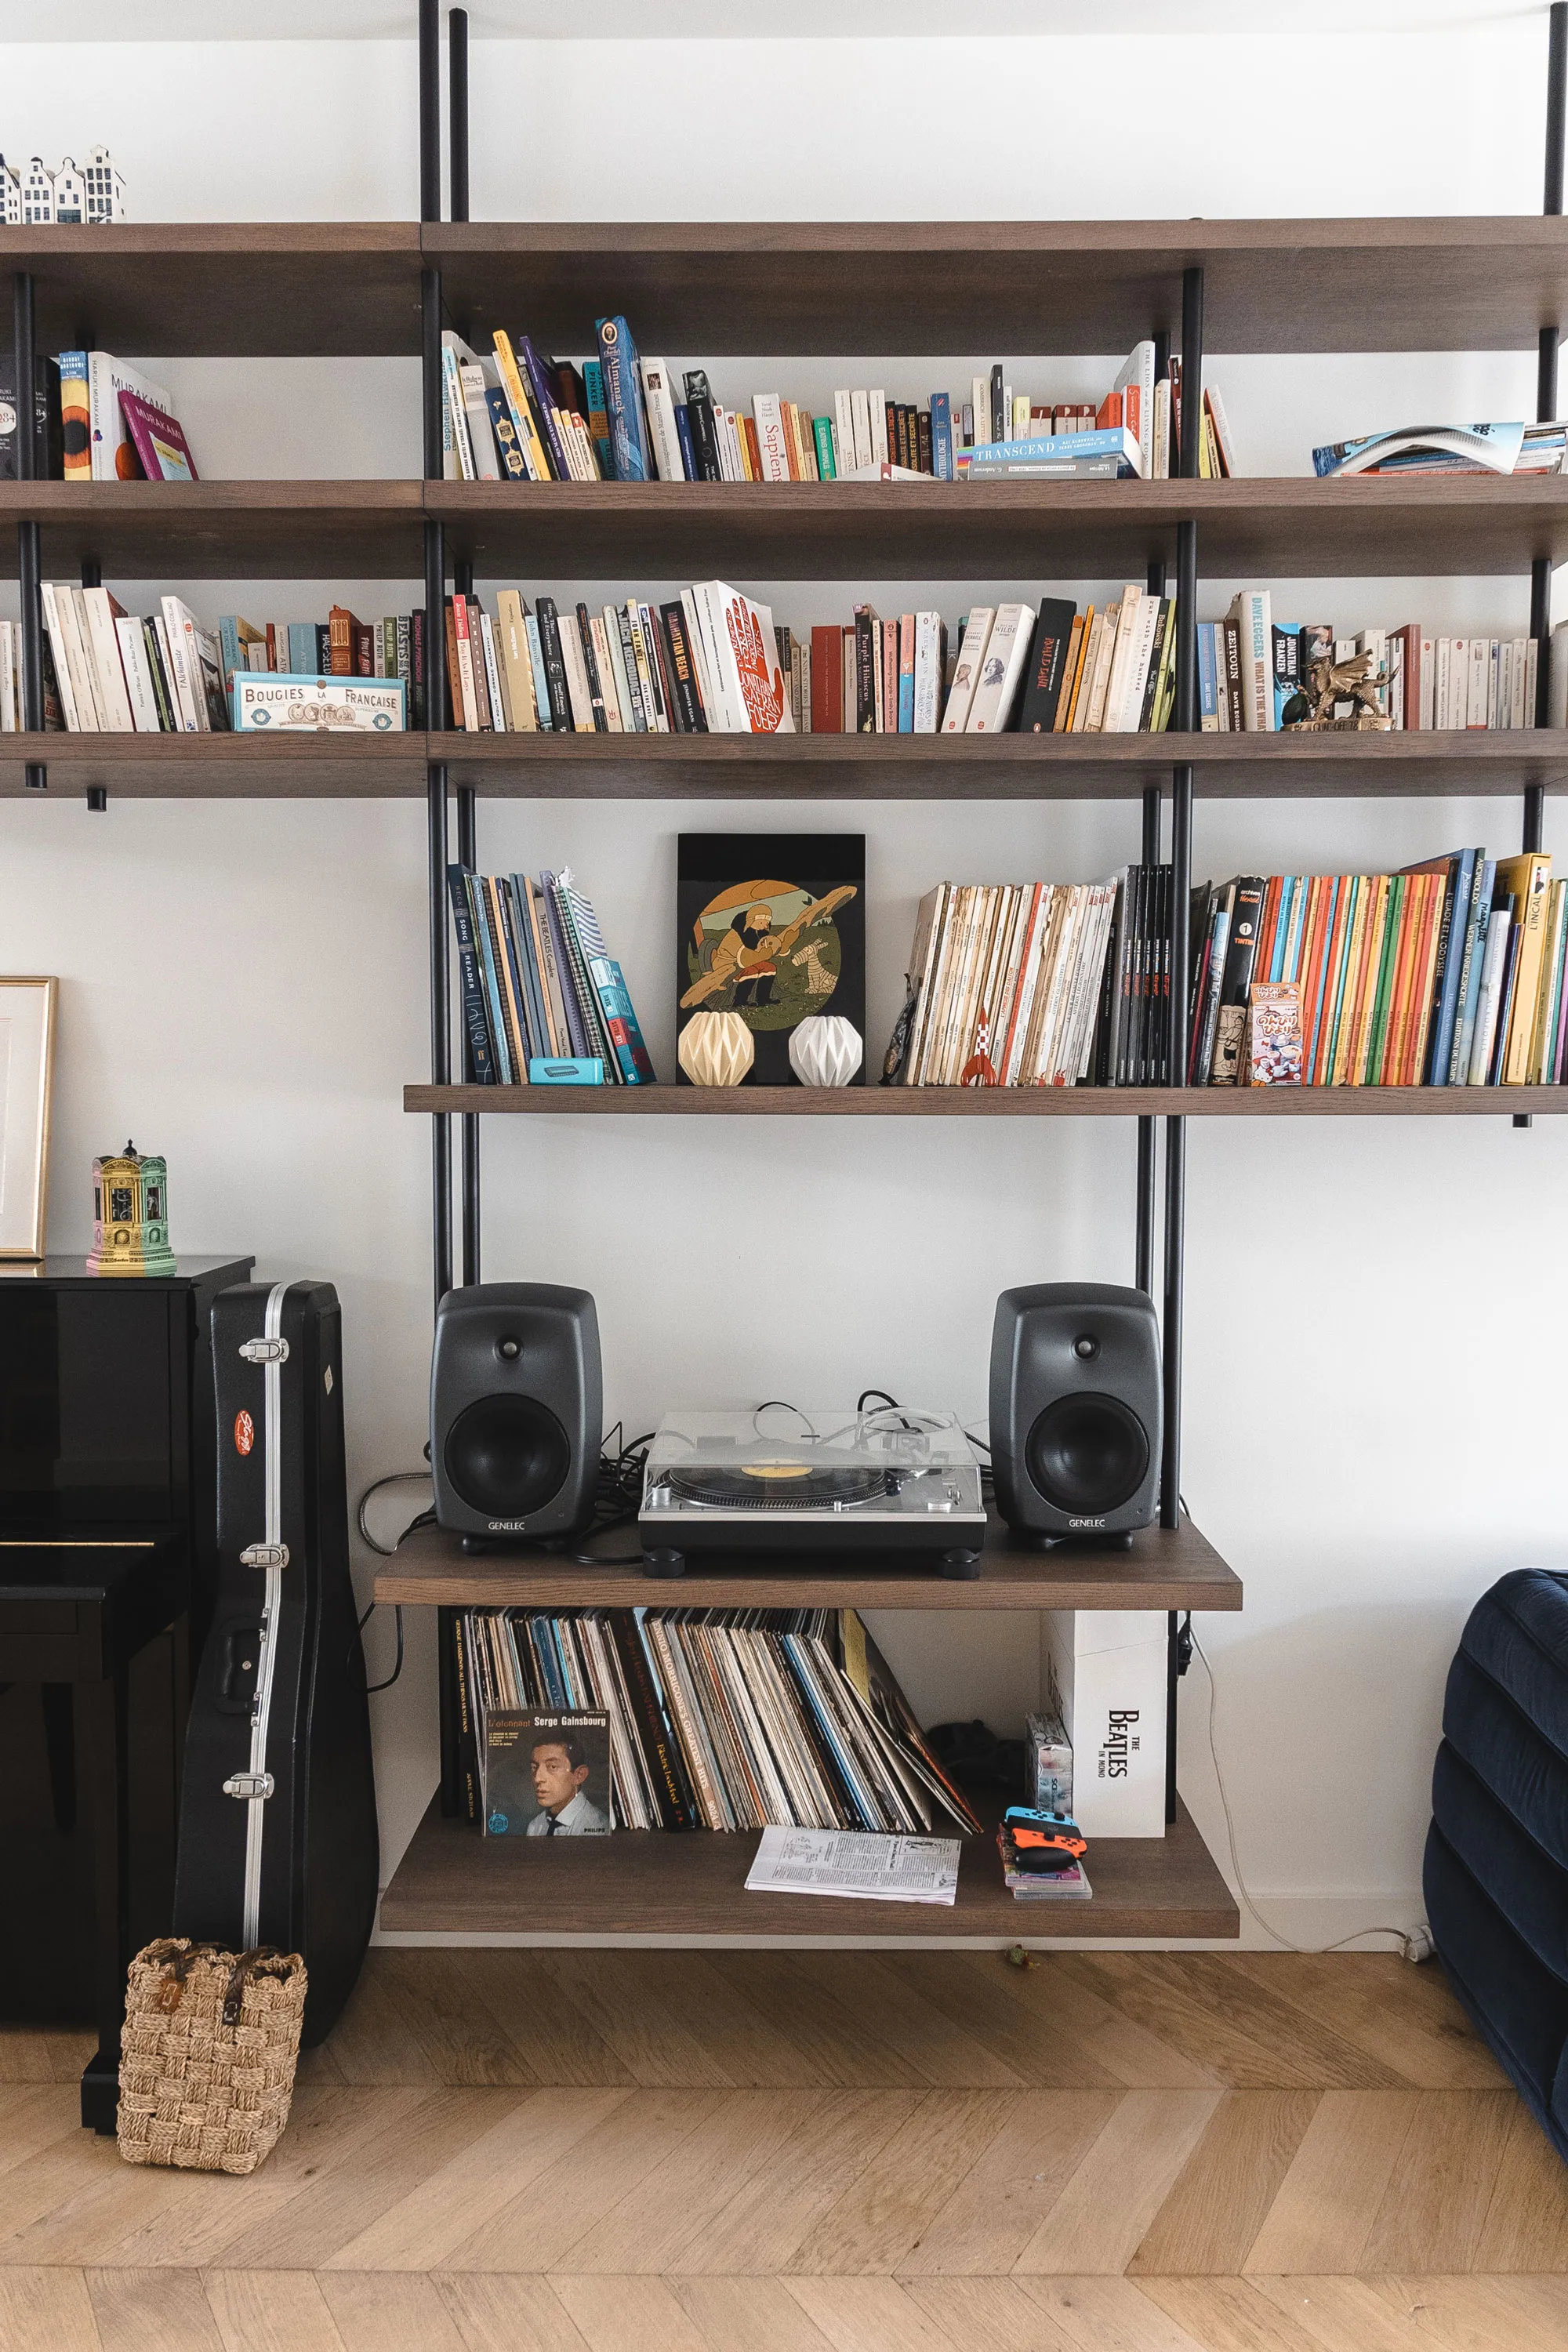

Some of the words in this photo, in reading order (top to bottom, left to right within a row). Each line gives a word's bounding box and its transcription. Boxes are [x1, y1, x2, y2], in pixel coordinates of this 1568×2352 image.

[586, 371, 599, 406] PINKER
[609, 357, 626, 413] Almanack
[91, 388, 100, 426] MURAKAMI
[652, 393, 662, 411] Proust
[135, 405, 183, 441] MURAKAMI
[443, 408, 452, 452] Stephen
[655, 410, 664, 429] Marcel
[887, 408, 895, 430] SECRET
[659, 436, 673, 467] imaginaire
[818, 426, 828, 448] EATING
[976, 442, 1055, 461] TRANSCEND
[764, 424, 782, 481] Sapiens
[166, 601, 176, 622] COELHO
[1251, 597, 1262, 621] DAVE
[169, 622, 178, 639] PAULO
[413, 614, 422, 645] THOMAS
[456, 618, 465, 638] Didion
[527, 619, 537, 637] John
[543, 624, 553, 656] Everywhere
[616, 612, 632, 644] JACK
[630, 619, 640, 638] JOHN
[665, 610, 685, 655] MANHATTAN
[1152, 612, 1166, 649] Bukowski
[1252, 622, 1264, 659] EGGERS
[320, 633, 333, 674] HAG-SEED
[360, 637, 370, 657] PHILIP
[468, 610, 485, 693] DEMOCRACY
[485, 636, 493, 667] McCARTHY
[529, 637, 542, 666] Banville
[633, 639, 644, 662] FANTE
[860, 633, 869, 662] Purple
[1040, 636, 1055, 666] ROALD
[1227, 630, 1239, 680] ZEITOUN
[1275, 638, 1287, 672] FRANZEN
[1284, 635, 1298, 675] JONATHAN
[173, 648, 188, 689] l'Alchimiste
[361, 658, 371, 675] ROTH
[414, 645, 423, 682] PYNCHON
[622, 644, 641, 696] KEROUAC
[674, 655, 690, 681] BEACH
[1082, 660, 1092, 685] Steinbeck
[1087, 639, 1095, 657] Tortilla
[1134, 662, 1145, 691] hunted
[556, 681, 564, 696] Geoff
[740, 670, 775, 697] JONATHAN
[862, 665, 870, 701] Hibiscus
[1035, 666, 1050, 689] DAHL
[1145, 680, 1155, 695] Office
[245, 688, 304, 702] BOUGIES
[345, 689, 397, 709] FRANÇAISE
[557, 695, 567, 715] Emerick
[682, 683, 692, 706] JENNIFER
[687, 707, 695, 723] EGAN
[742, 687, 781, 715] SAFRAN
[746, 702, 777, 731] FOER
[454, 884, 463, 906] BECK
[1470, 858, 1485, 905] ARCIMBOLDO
[539, 913, 547, 927] THE
[1442, 891, 1456, 923] L'ILIADE
[1528, 894, 1542, 931] L'INCAL
[459, 918, 468, 941] SONG
[541, 926, 551, 953] BEATLES
[1441, 924, 1450, 933] ET
[1463, 923, 1475, 954] WERNER
[463, 954, 474, 989] READER
[544, 953, 555, 978] Complete
[1006, 966, 1014, 985] DALTON
[1455, 954, 1473, 1007] KRIEGESKORTE
[1452, 1017, 1463, 1049] EDITIONS
[1450, 1048, 1459, 1060] DU
[1447, 1060, 1457, 1082] TEMPS
[488, 1522, 525, 1530] GENELEC
[652, 1621, 669, 1652] ENNIO
[661, 1652, 689, 1719] MORRICONE'S
[681, 1719, 703, 1767] GREATEST
[695, 1766, 710, 1789] HITS
[488, 1719, 531, 1728] L'étonnant
[534, 1717, 557, 1728] Serge
[561, 1716, 606, 1727] Gainsbourg
[654, 1742, 673, 1771] Electric
[1103, 1710, 1139, 1778] BEATLES
[1131, 1736, 1140, 1751] THE
[660, 1769, 682, 1805] Ladyland
